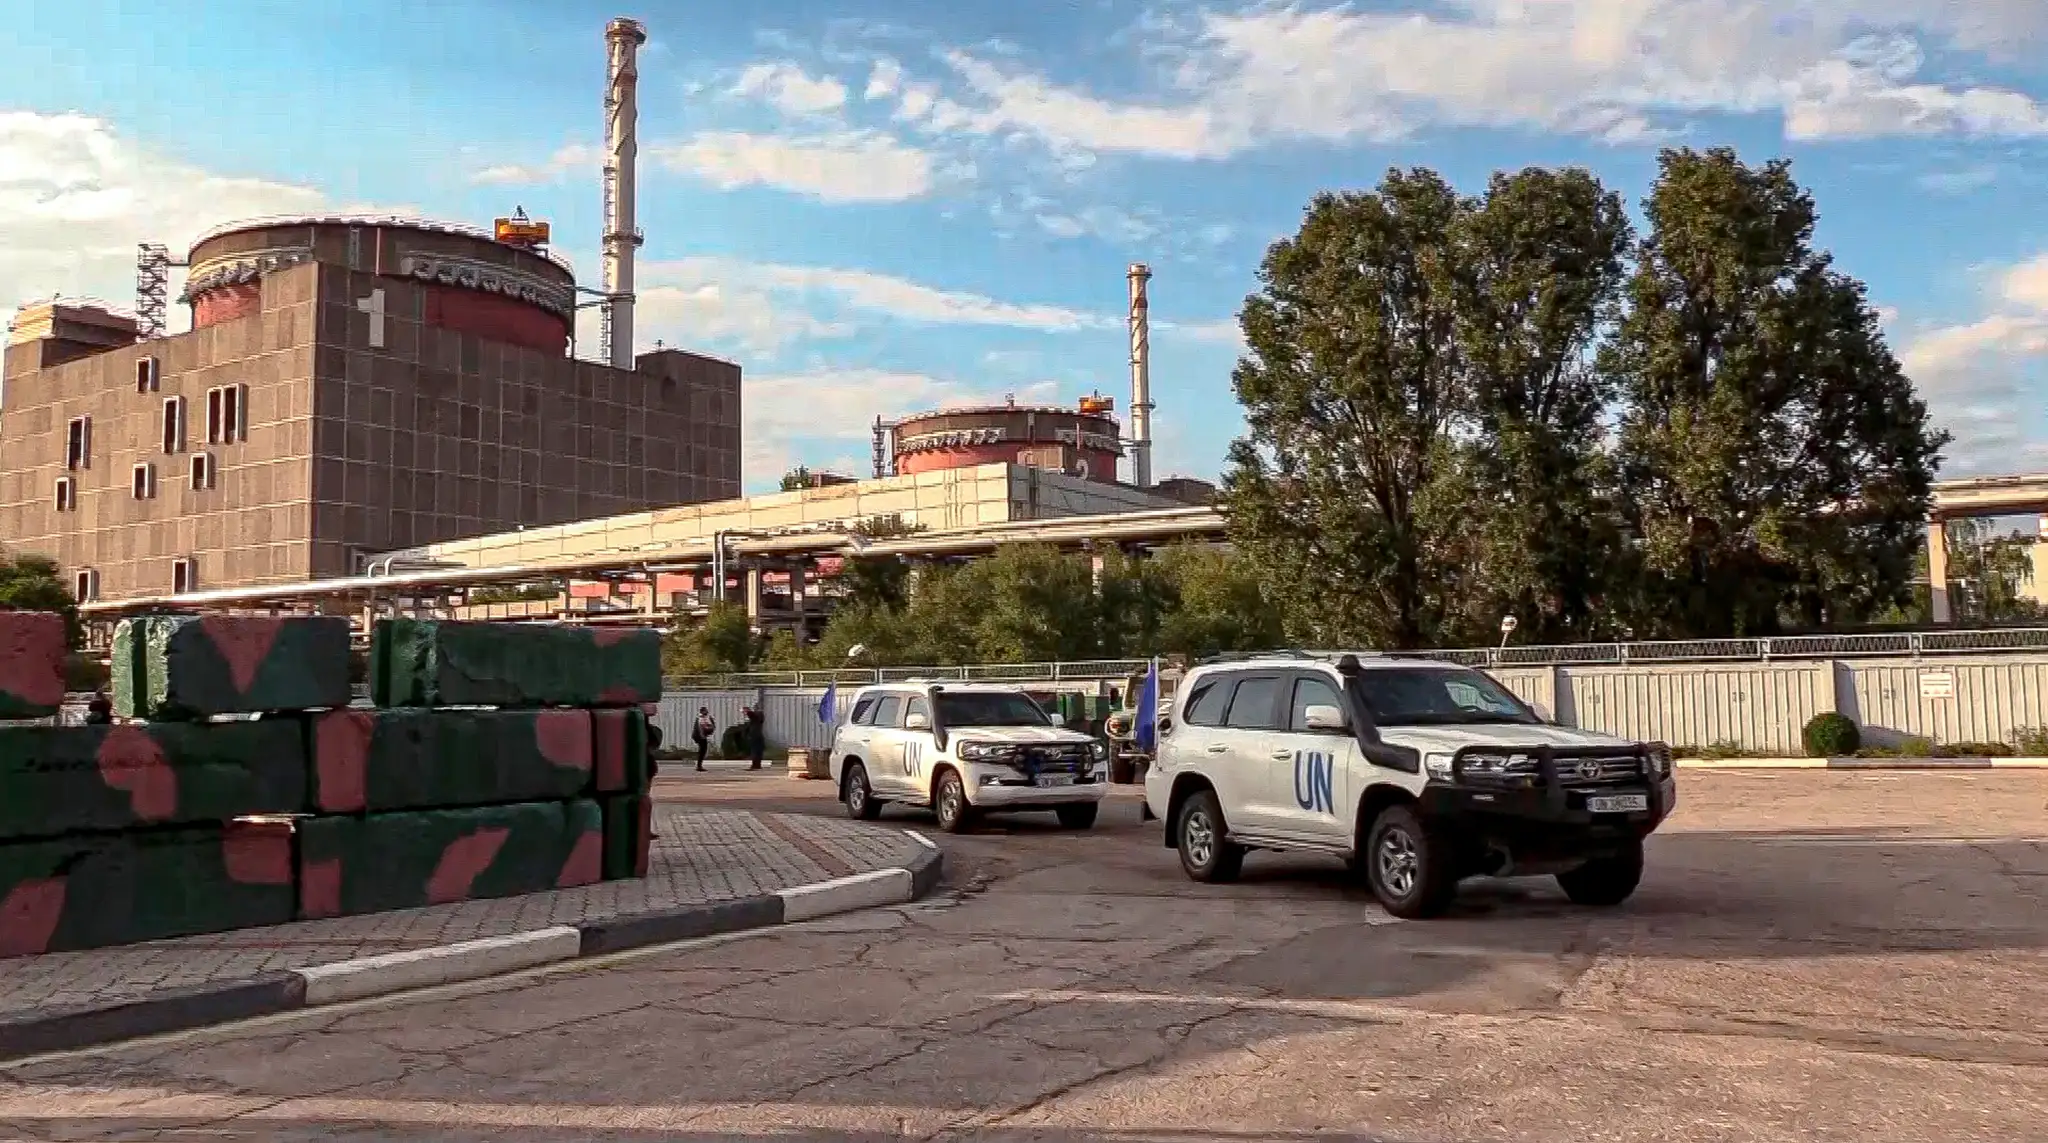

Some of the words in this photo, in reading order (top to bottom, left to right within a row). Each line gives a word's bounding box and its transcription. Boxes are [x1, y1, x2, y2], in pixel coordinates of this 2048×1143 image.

[357, 288, 386, 347] 1
[903, 741, 922, 777] UN
[1295, 750, 1335, 816] UN
